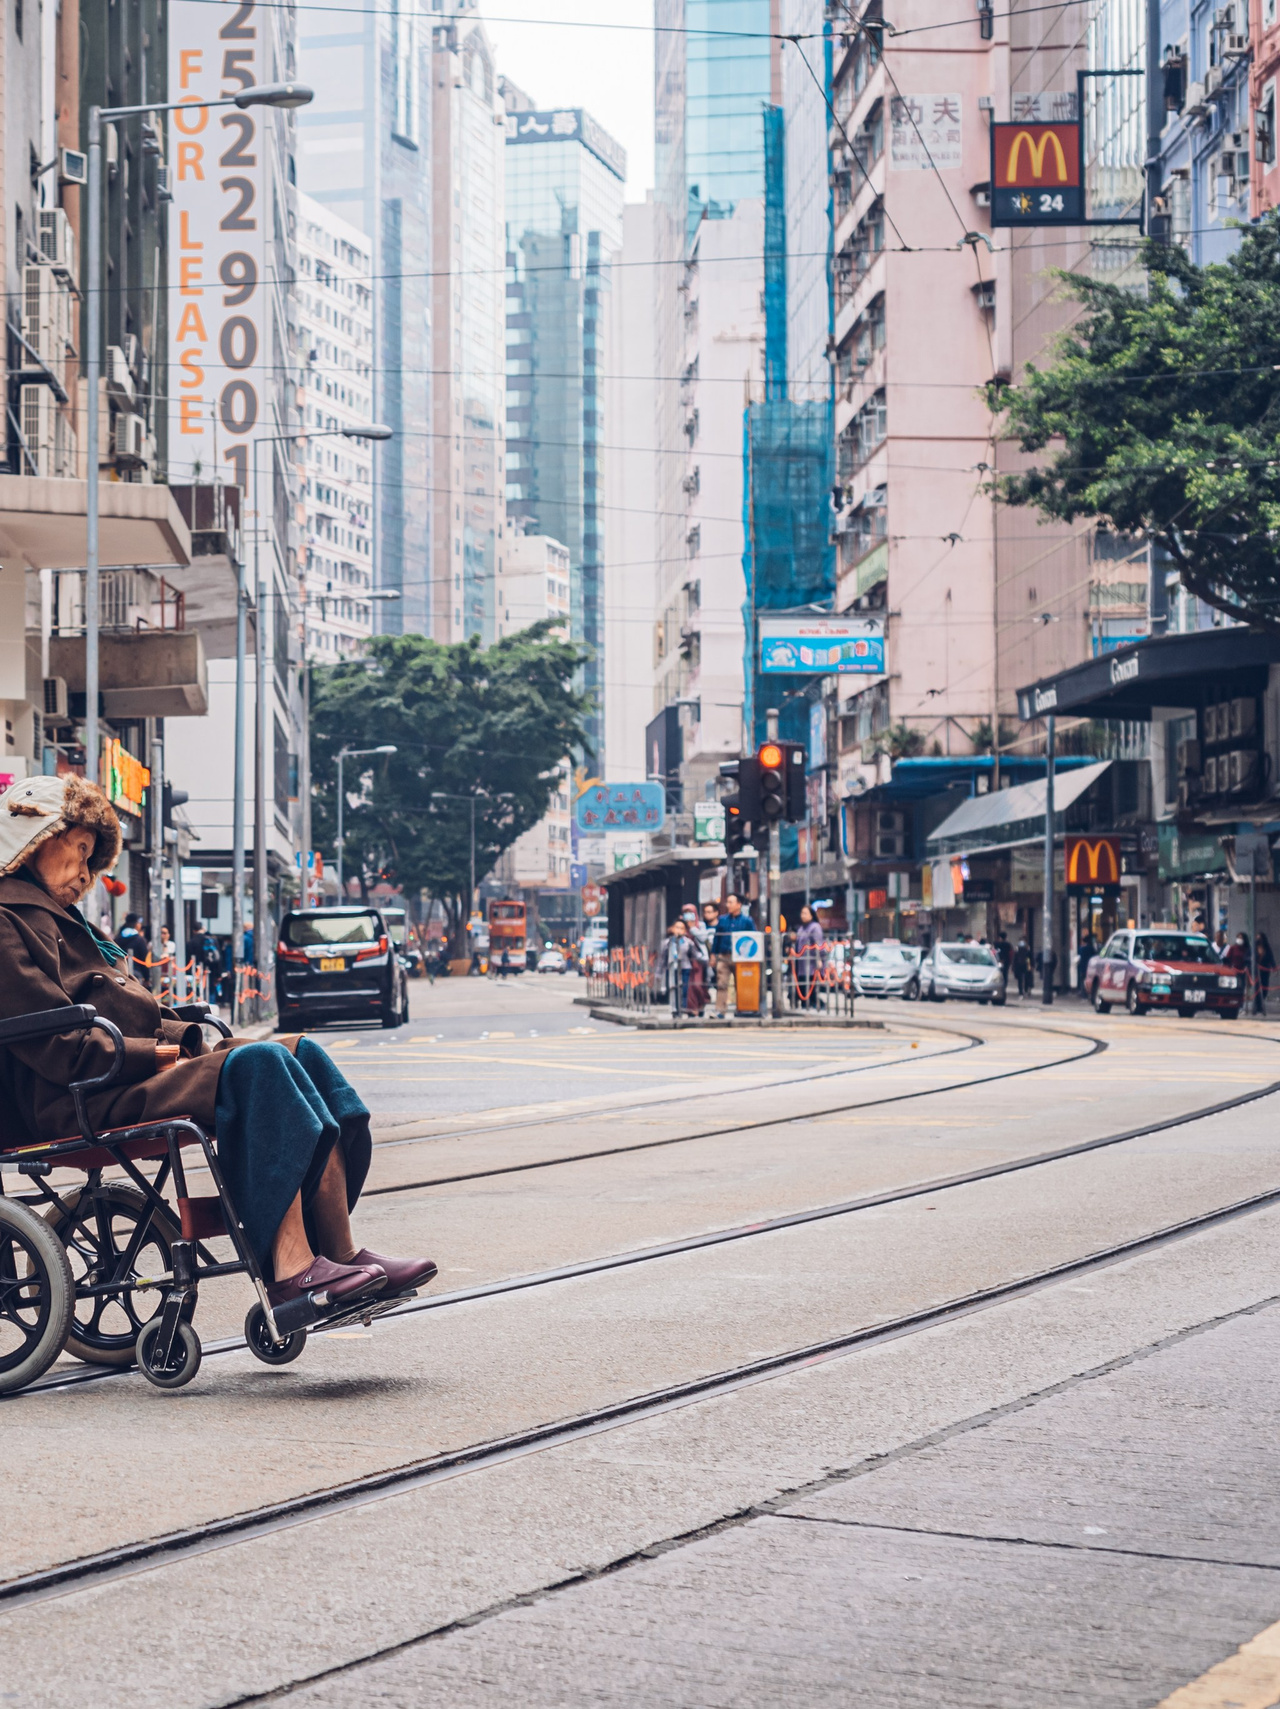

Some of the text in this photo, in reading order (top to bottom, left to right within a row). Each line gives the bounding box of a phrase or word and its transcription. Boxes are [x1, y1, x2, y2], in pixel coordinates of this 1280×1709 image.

[173, 49, 210, 181] FOR
[1039, 193, 1065, 213] 24
[175, 210, 209, 435] LEASE
